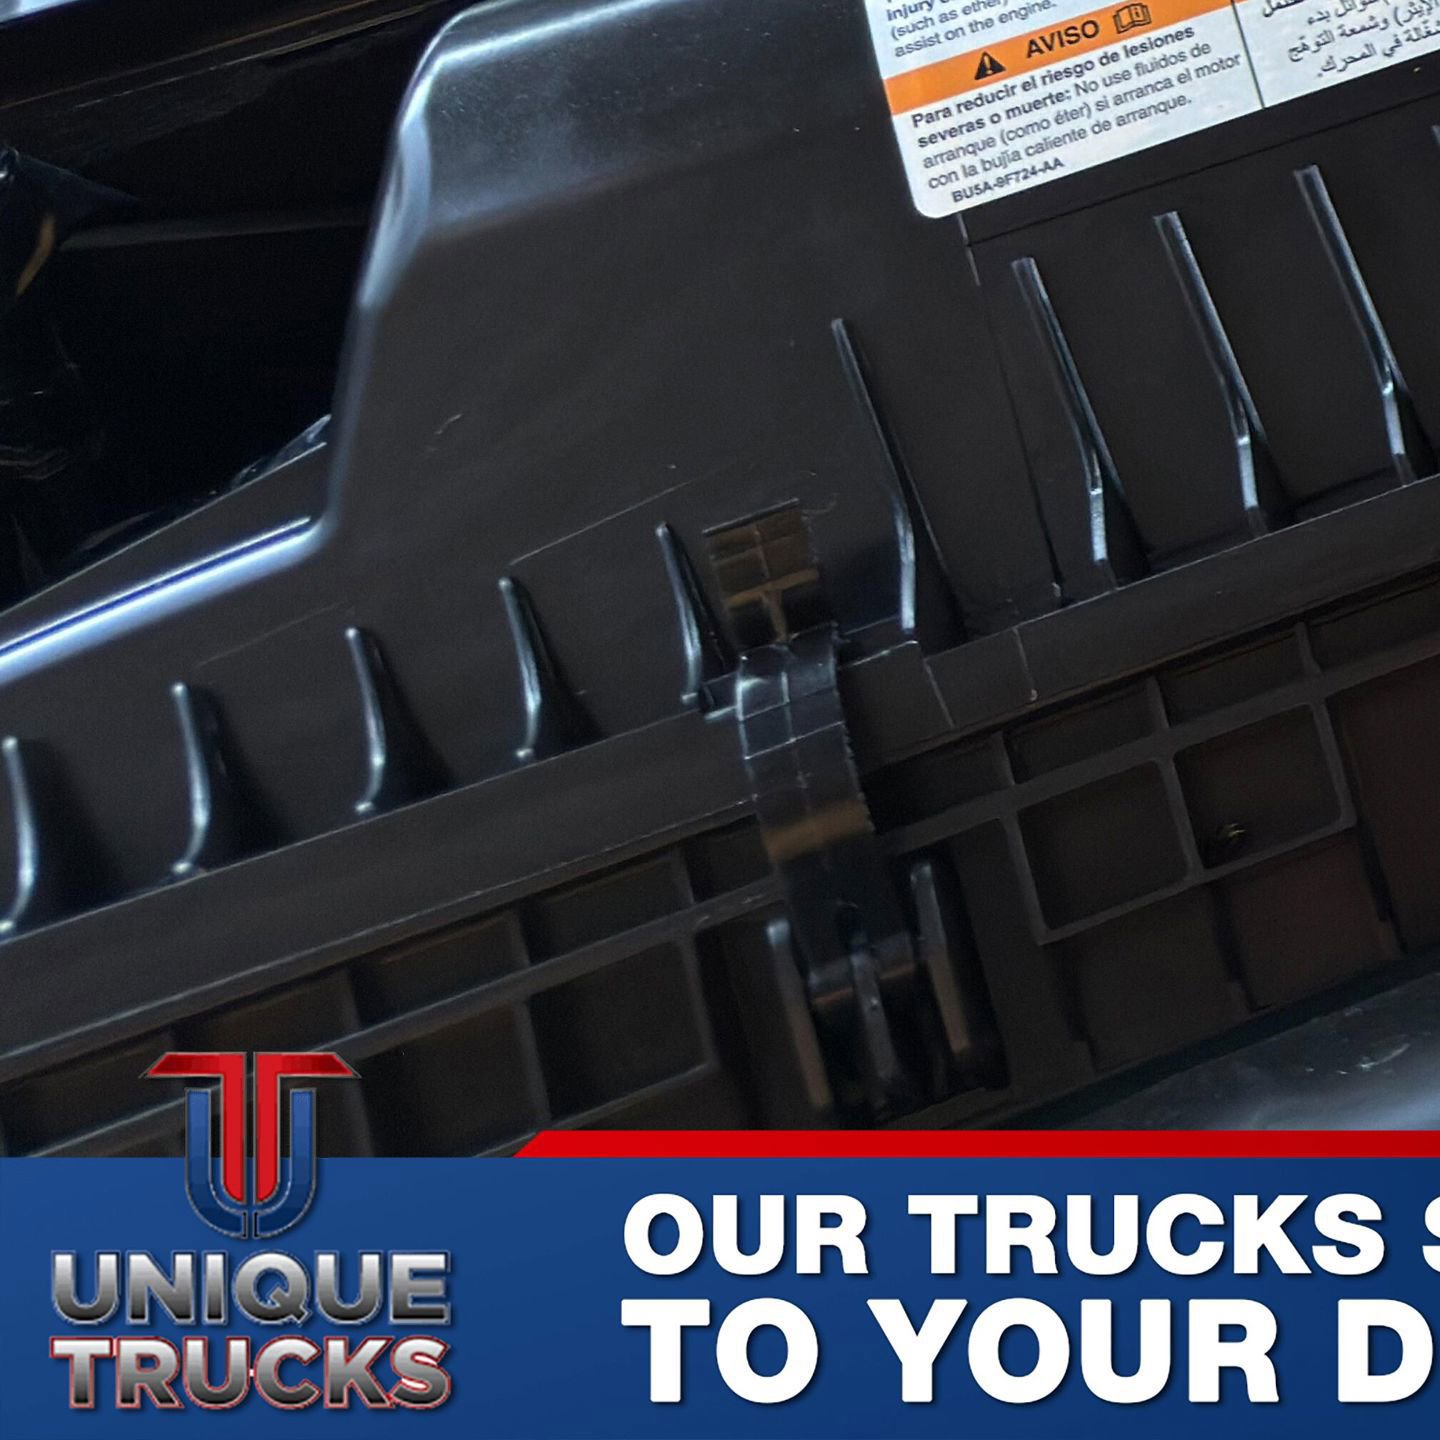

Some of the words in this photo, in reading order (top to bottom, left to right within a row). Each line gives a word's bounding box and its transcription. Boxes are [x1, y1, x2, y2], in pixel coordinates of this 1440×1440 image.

[890, 16, 935, 41] (such
[938, 9, 959, 24] as
[894, 32, 943, 58] assist
[944, 26, 966, 41] on
[968, 17, 995, 34] the
[998, 0, 1057, 24] engine.
[1026, 19, 1100, 59] AVISO
[911, 106, 953, 128] Para
[956, 84, 1017, 114] reducir
[1020, 75, 1038, 92] el
[1040, 60, 1095, 86] riesgo
[1098, 51, 1120, 67] de
[1122, 27, 1195, 59] lesiones
[917, 118, 986, 148] severas
[989, 112, 1002, 125] o
[1005, 89, 1072, 120] muerte:
[1074, 80, 1099, 97] No
[1102, 69, 1132, 88] use
[1134, 51, 1188, 77] fluidos
[1190, 43, 1212, 59] de
[922, 136, 996, 169] arranque
[1000, 118, 1051, 146] (como
[1054, 102, 1092, 126] éter)
[1095, 95, 1110, 112] si
[1112, 77, 1175, 107] arranca
[1176, 67, 1193, 85] el
[1194, 54, 1241, 79] motor
[928, 170, 960, 189] con
[961, 164, 979, 178] la
[980, 150, 1023, 172] bujía
[1024, 128, 1087, 157] caliente
[1090, 120, 1112, 135] de
[1115, 94, 1192, 127] arranque.
